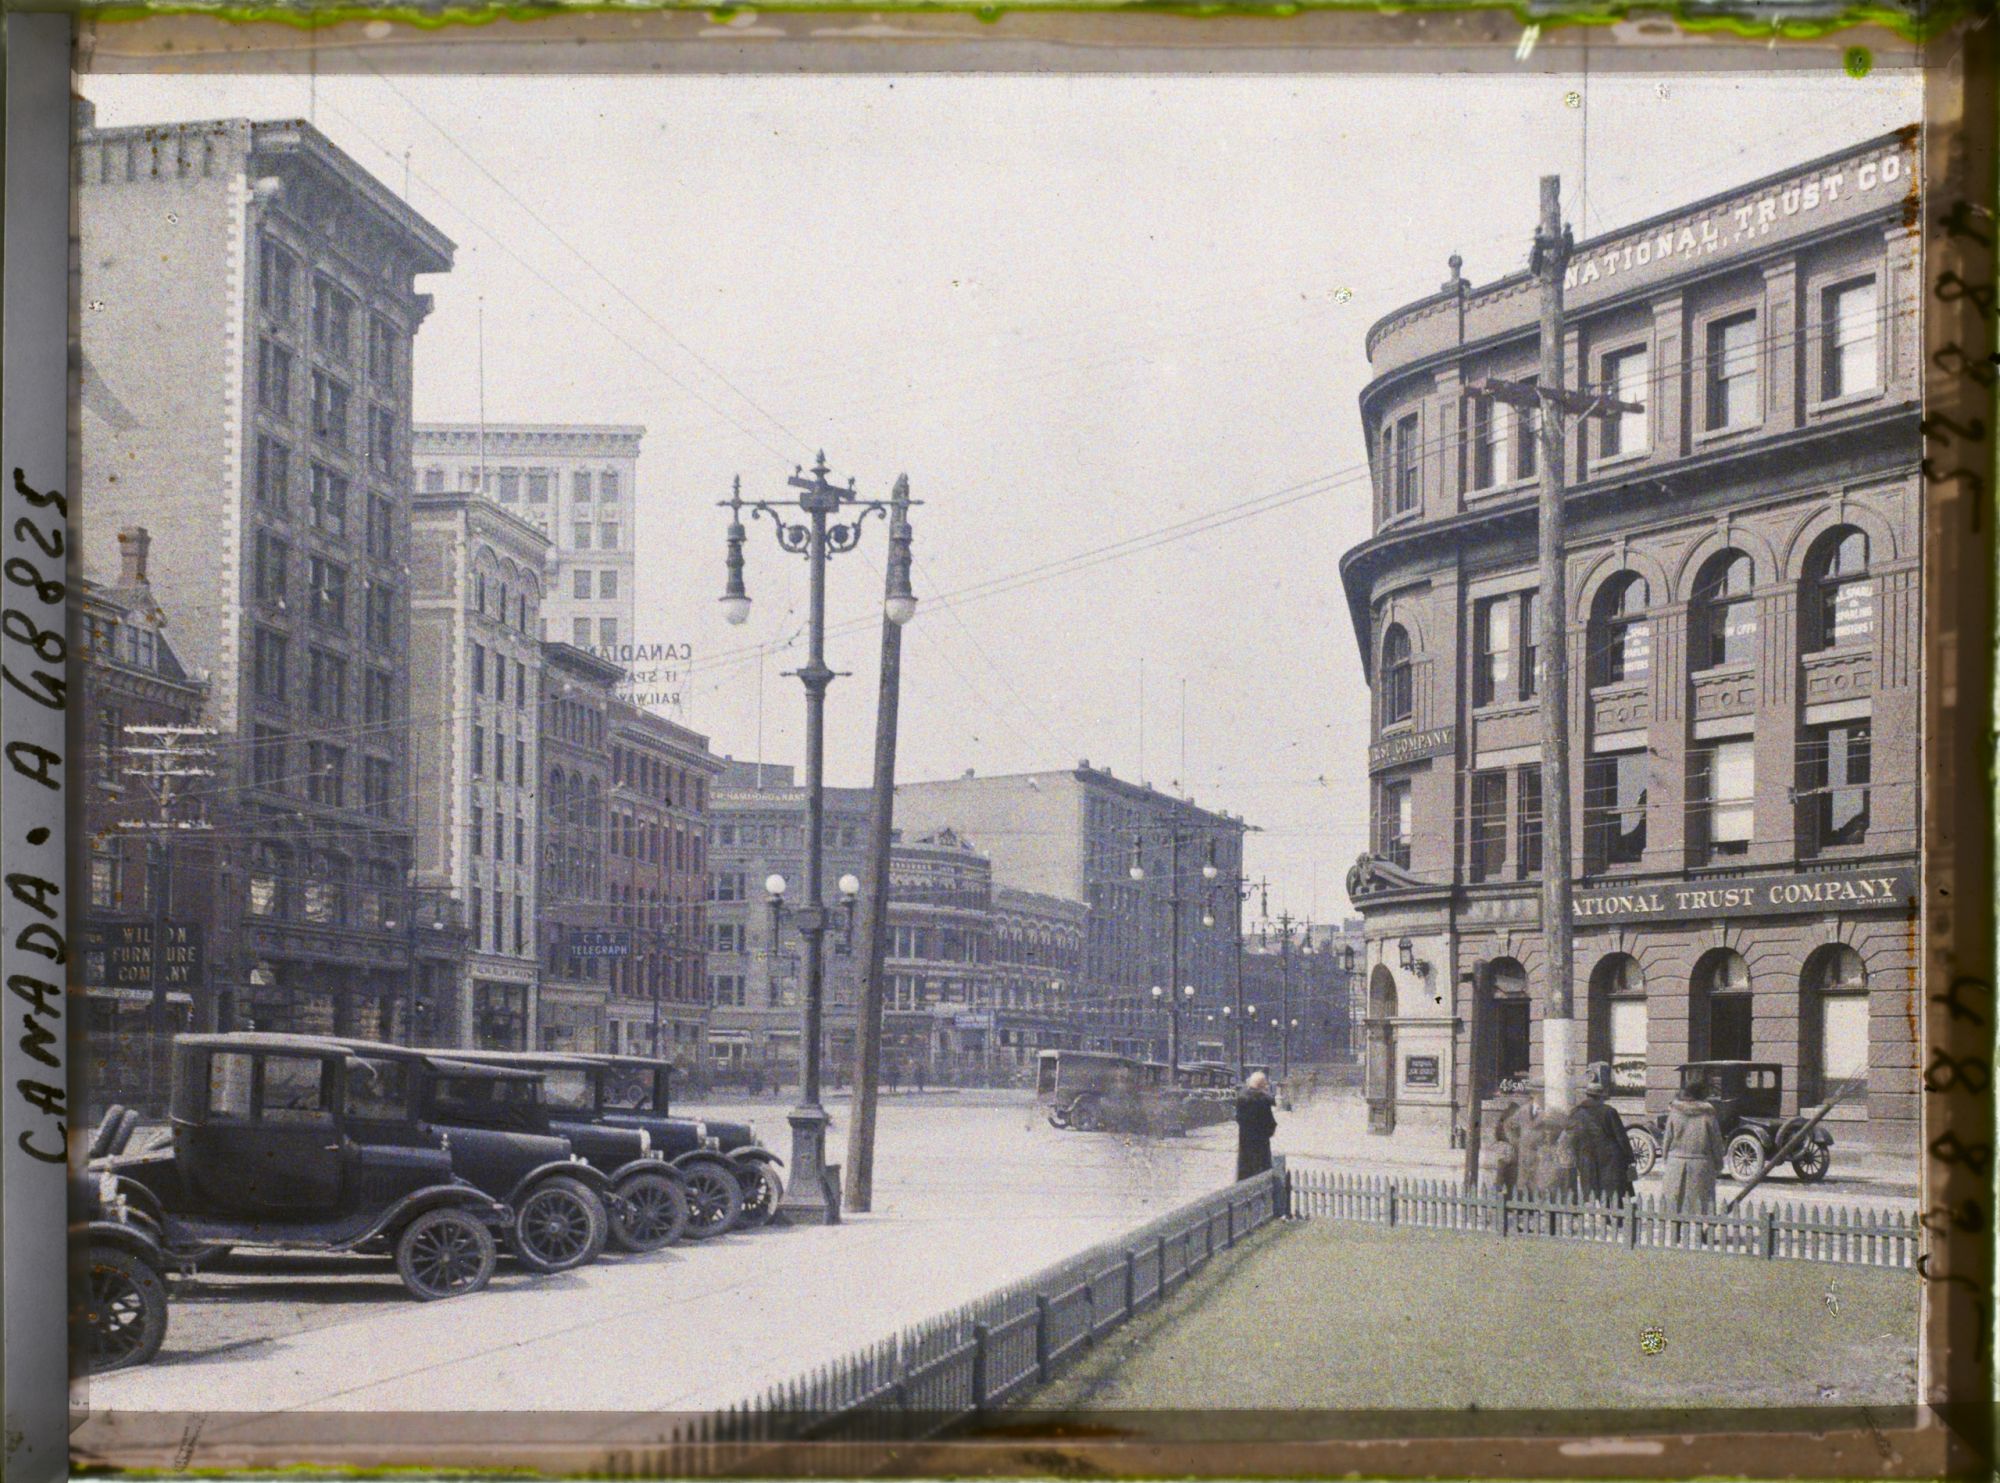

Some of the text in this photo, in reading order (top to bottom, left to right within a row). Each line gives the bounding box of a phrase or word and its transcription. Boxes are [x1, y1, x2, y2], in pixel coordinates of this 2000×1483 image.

[1563, 154, 1912, 290] NATIONAL TRUST CO.
[1685, 223, 1769, 259] LIMITED
[1395, 729, 1450, 754] COMPANY
[5, 740, 62, 791] A
[1572, 877, 1898, 917] ATIONAL TRUST COMPANY
[123, 927, 187, 943] WILON
[571, 945, 627, 955] TELEGRAPH
[112, 946, 197, 962] FURNURE
[118, 966, 191, 982] COMNY
[4, 872, 67, 1162] CANADA
